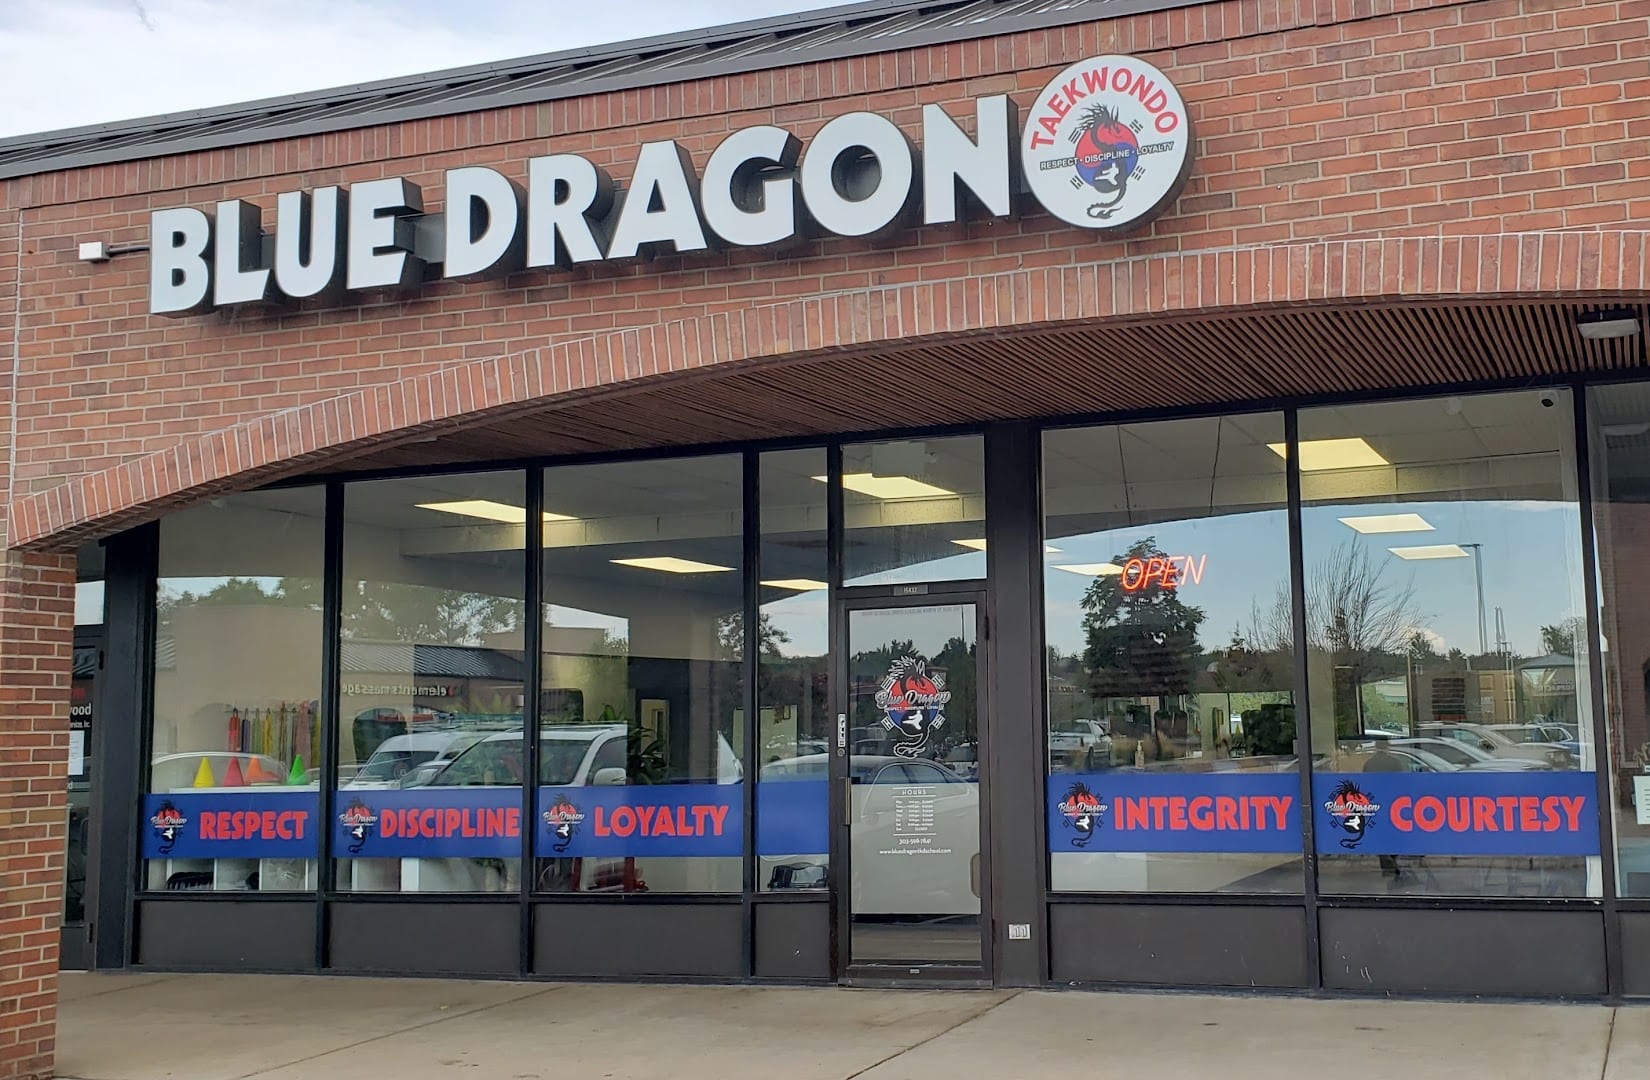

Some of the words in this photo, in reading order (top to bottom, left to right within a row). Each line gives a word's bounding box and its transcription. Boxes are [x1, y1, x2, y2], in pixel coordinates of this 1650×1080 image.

[1030, 66, 1179, 150] TAEKWONDO
[1040, 157, 1079, 171] RESPECT
[1085, 149, 1130, 164] DISCIPLINE
[1136, 141, 1175, 156] LOYALTY
[149, 177, 406, 313] BLUE
[443, 94, 1011, 278] DRAGON
[1122, 554, 1207, 590] OPEN
[71, 702, 92, 716] ood
[875, 690, 904, 709] Blue
[905, 689, 951, 706] Dragon
[199, 811, 308, 840] RESPECT
[380, 808, 520, 838] DISCIPLINE
[593, 805, 729, 837] LOYALTY
[1113, 796, 1293, 831] INTEGRITY
[1389, 795, 1586, 833] COURTESY
